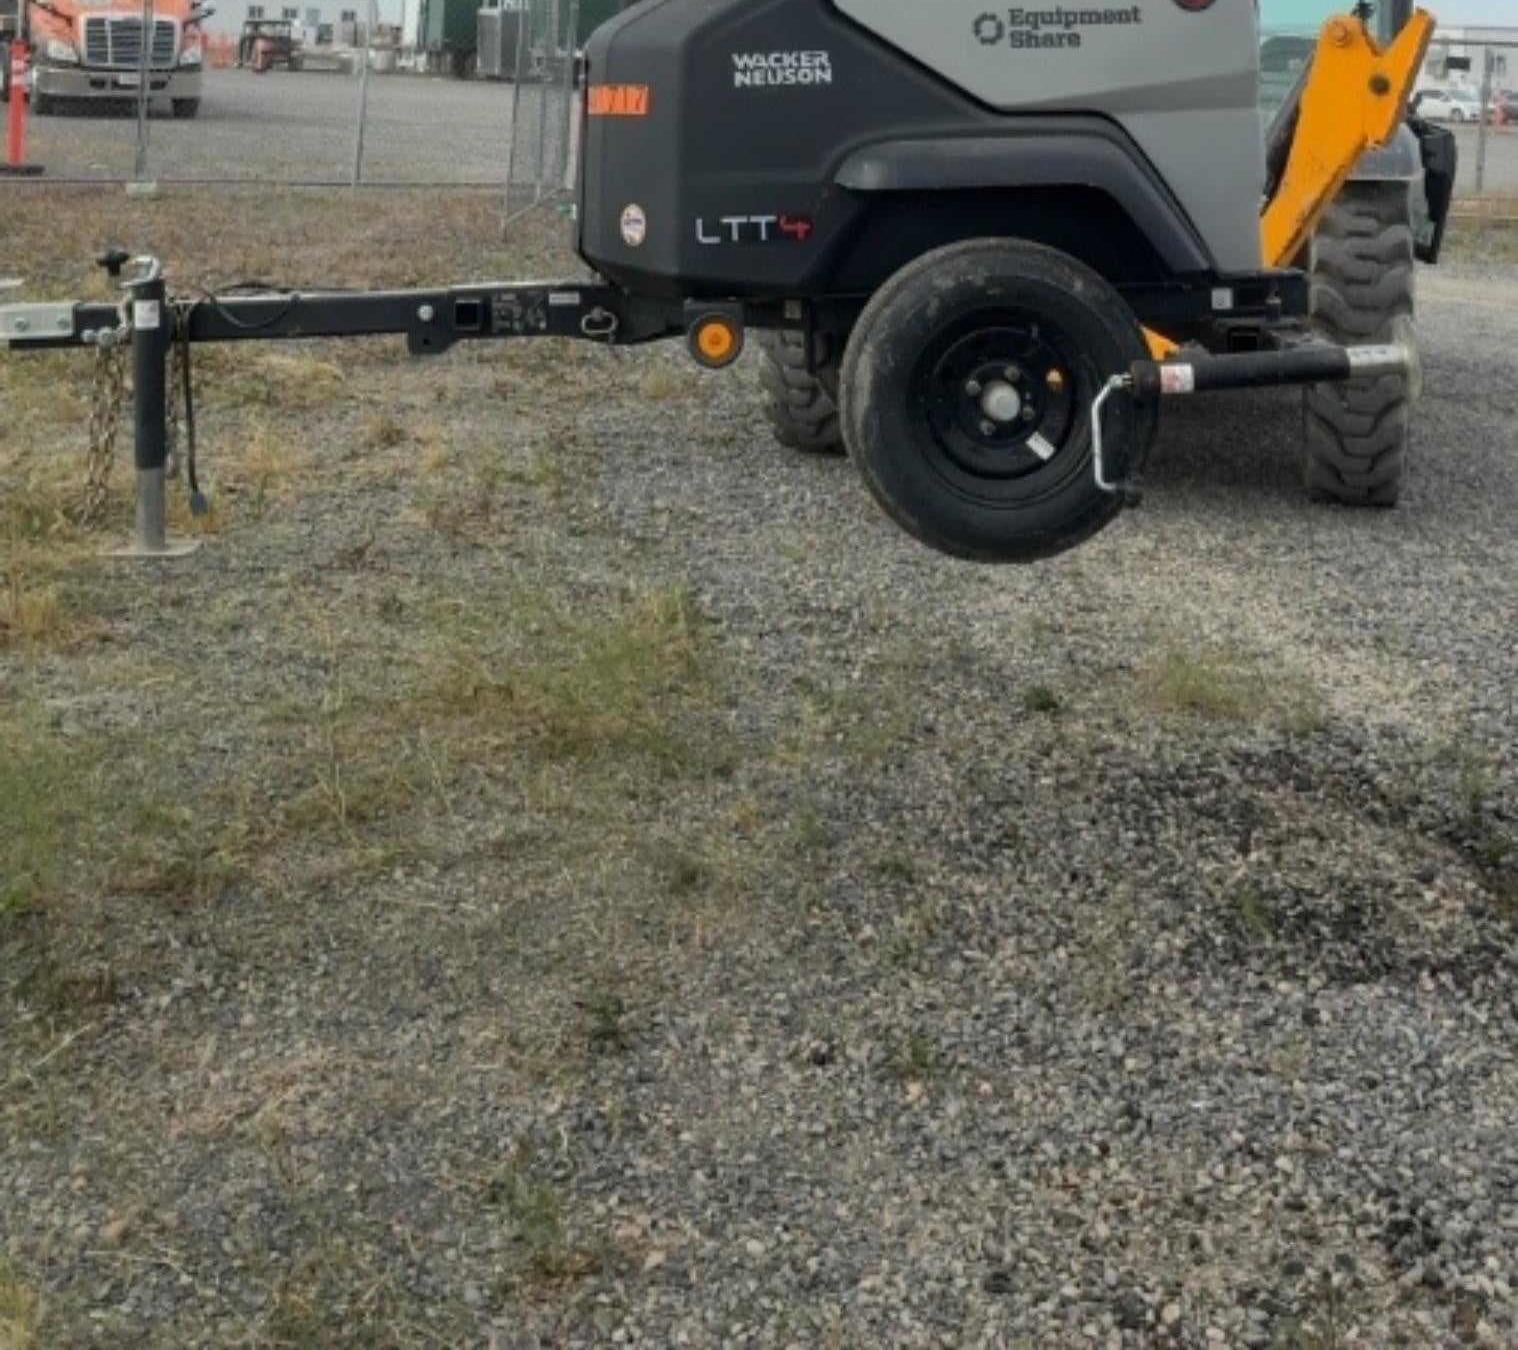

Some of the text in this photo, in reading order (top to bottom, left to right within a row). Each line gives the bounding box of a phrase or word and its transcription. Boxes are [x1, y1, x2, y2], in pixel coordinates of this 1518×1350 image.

[1008, 5, 1141, 30] Equipment
[1009, 29, 1082, 49] Share
[731, 51, 831, 69] WACKER
[734, 69, 832, 87] NEUSON
